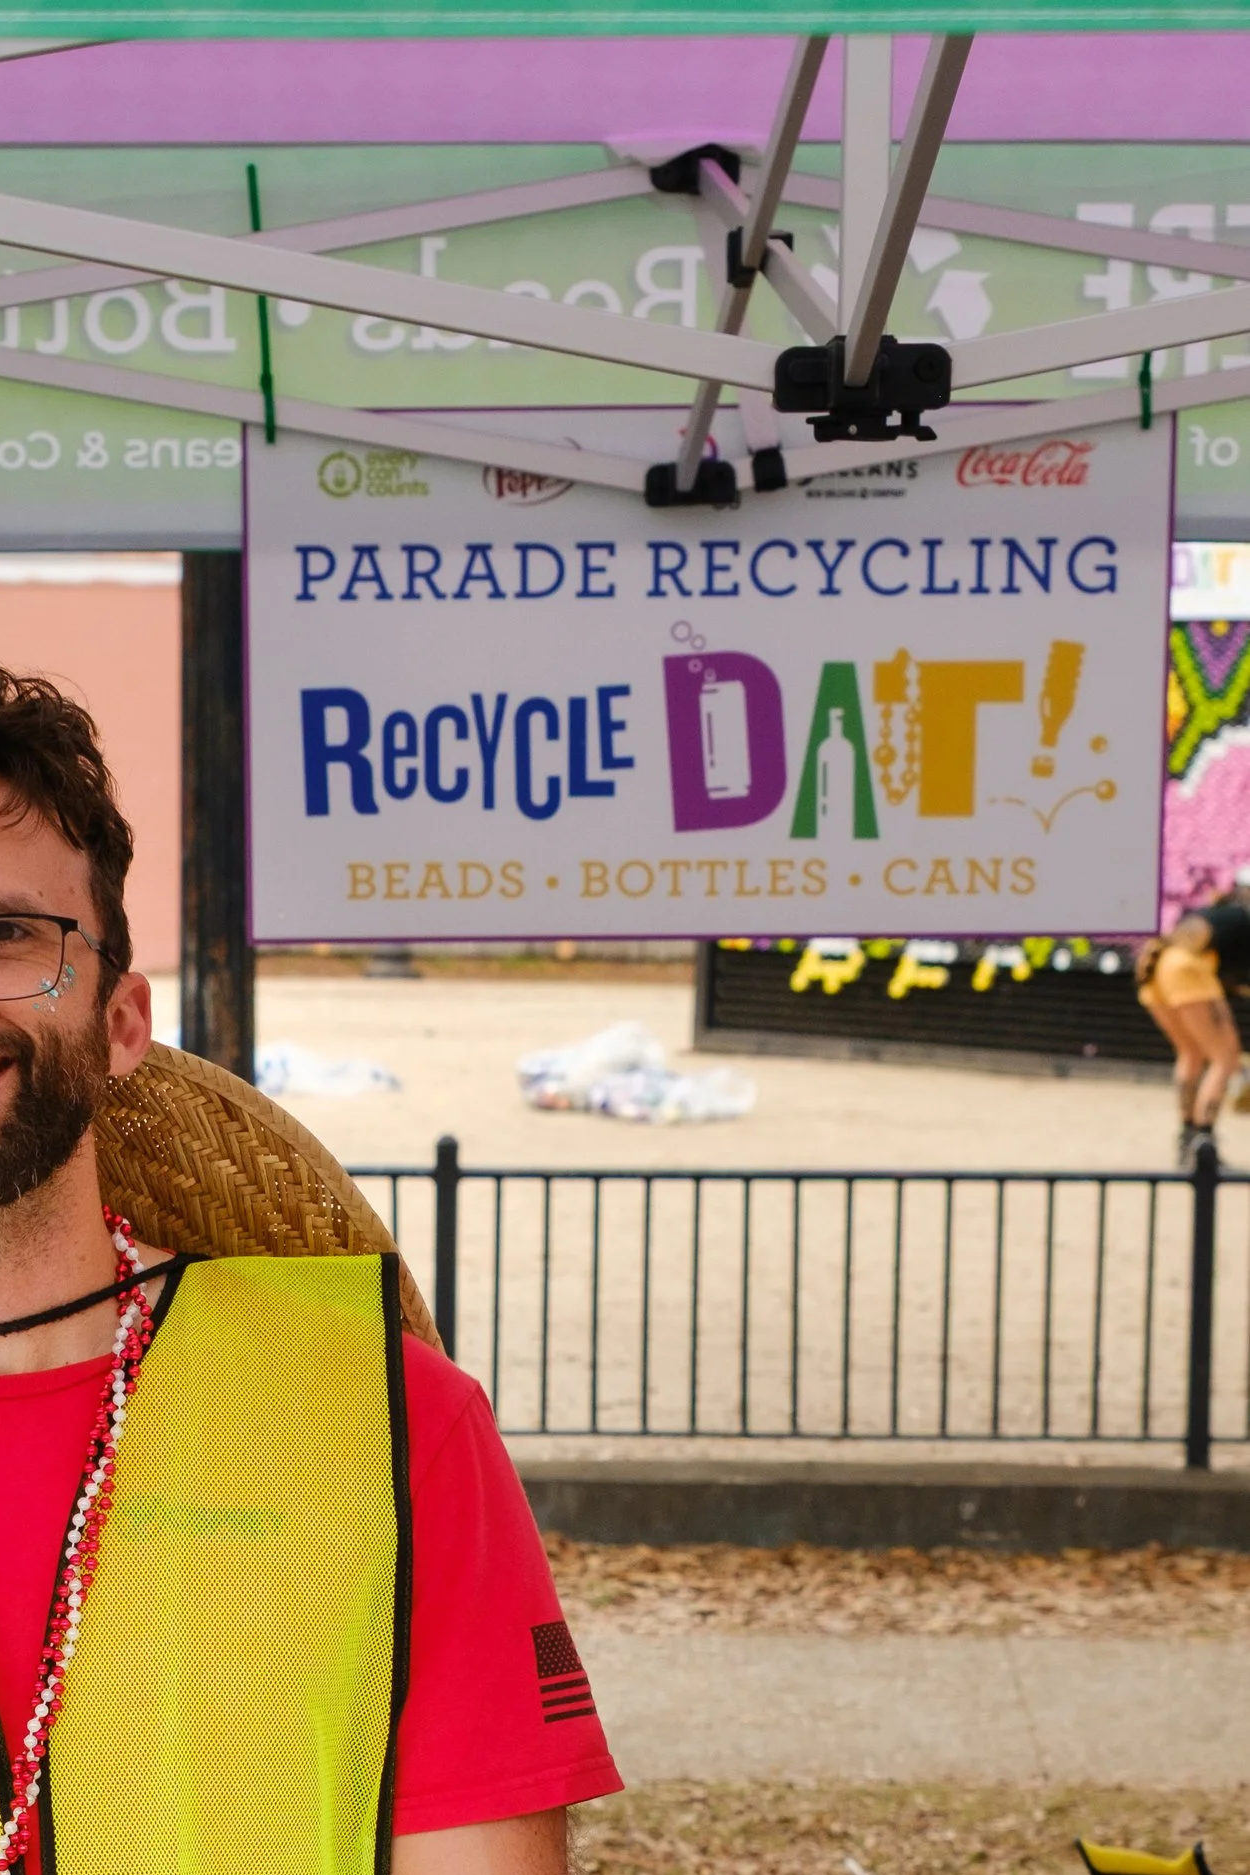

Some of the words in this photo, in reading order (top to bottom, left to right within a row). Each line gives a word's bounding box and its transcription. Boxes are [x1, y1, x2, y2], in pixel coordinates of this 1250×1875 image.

[295, 543, 616, 601] PARADE
[647, 537, 1118, 597] RECYCLING
[347, 860, 526, 900] BEADS
[579, 858, 828, 898] BOTTLES
[883, 857, 1037, 896] CANS
